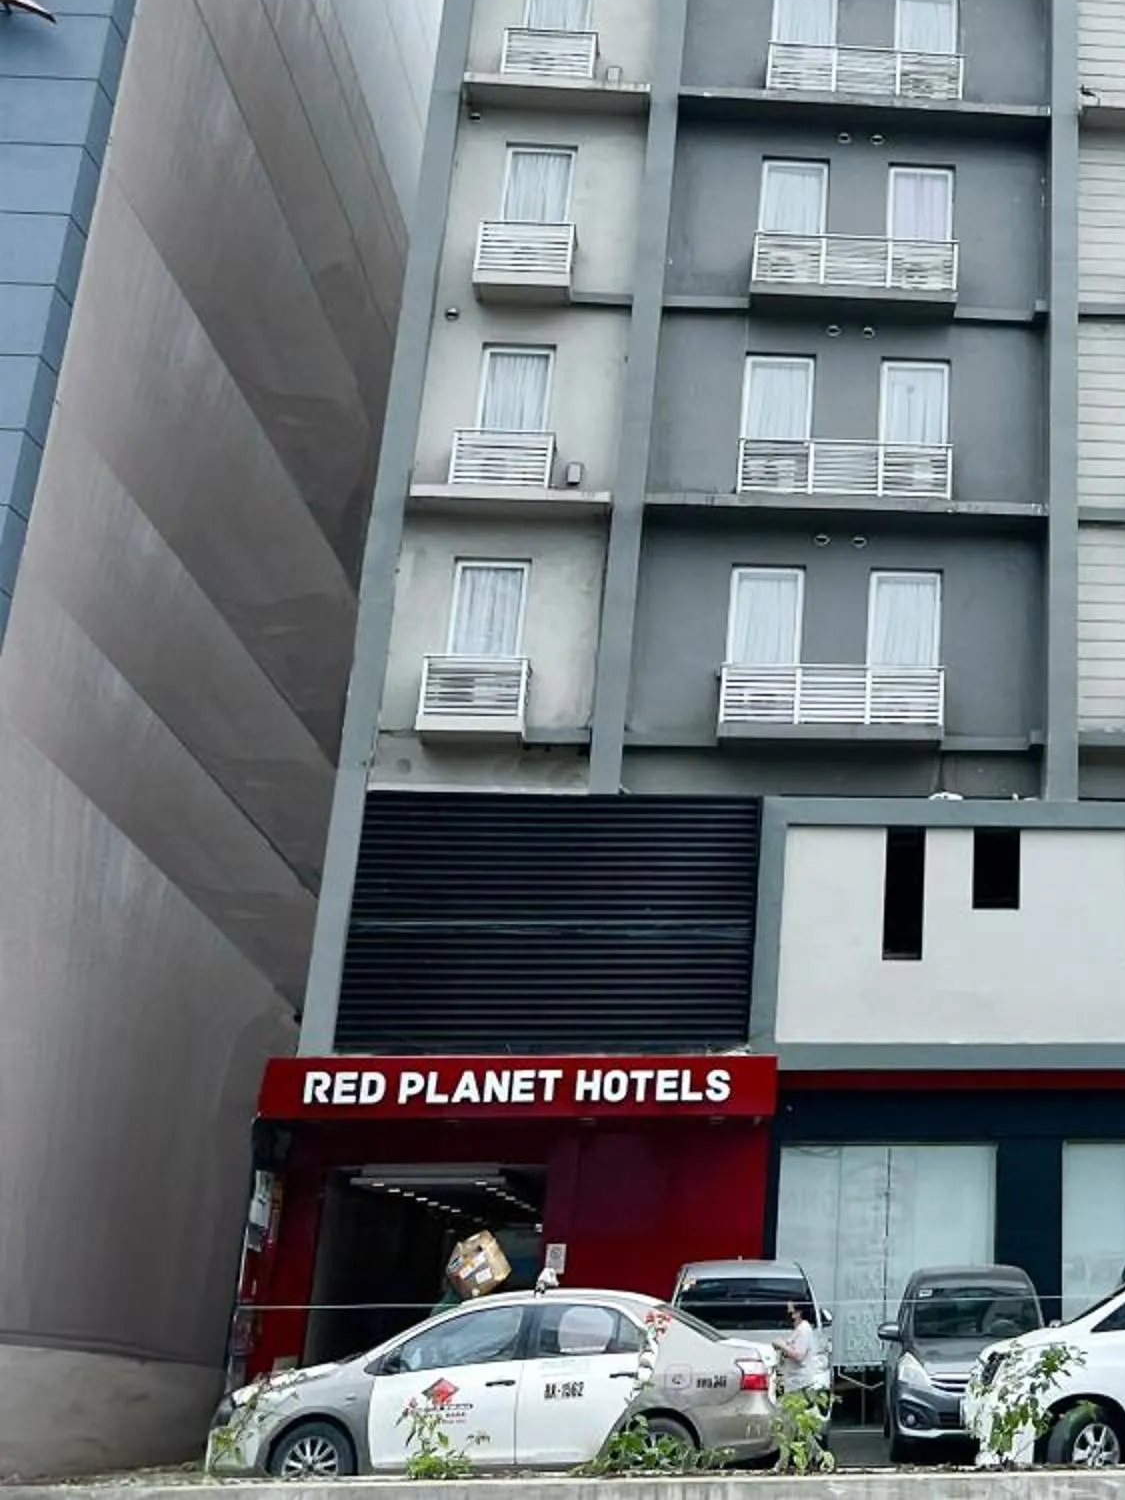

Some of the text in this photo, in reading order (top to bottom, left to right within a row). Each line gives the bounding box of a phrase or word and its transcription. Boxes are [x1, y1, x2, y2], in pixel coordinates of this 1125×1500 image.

[303, 1068, 731, 1105] RED PLANET HOTELS
